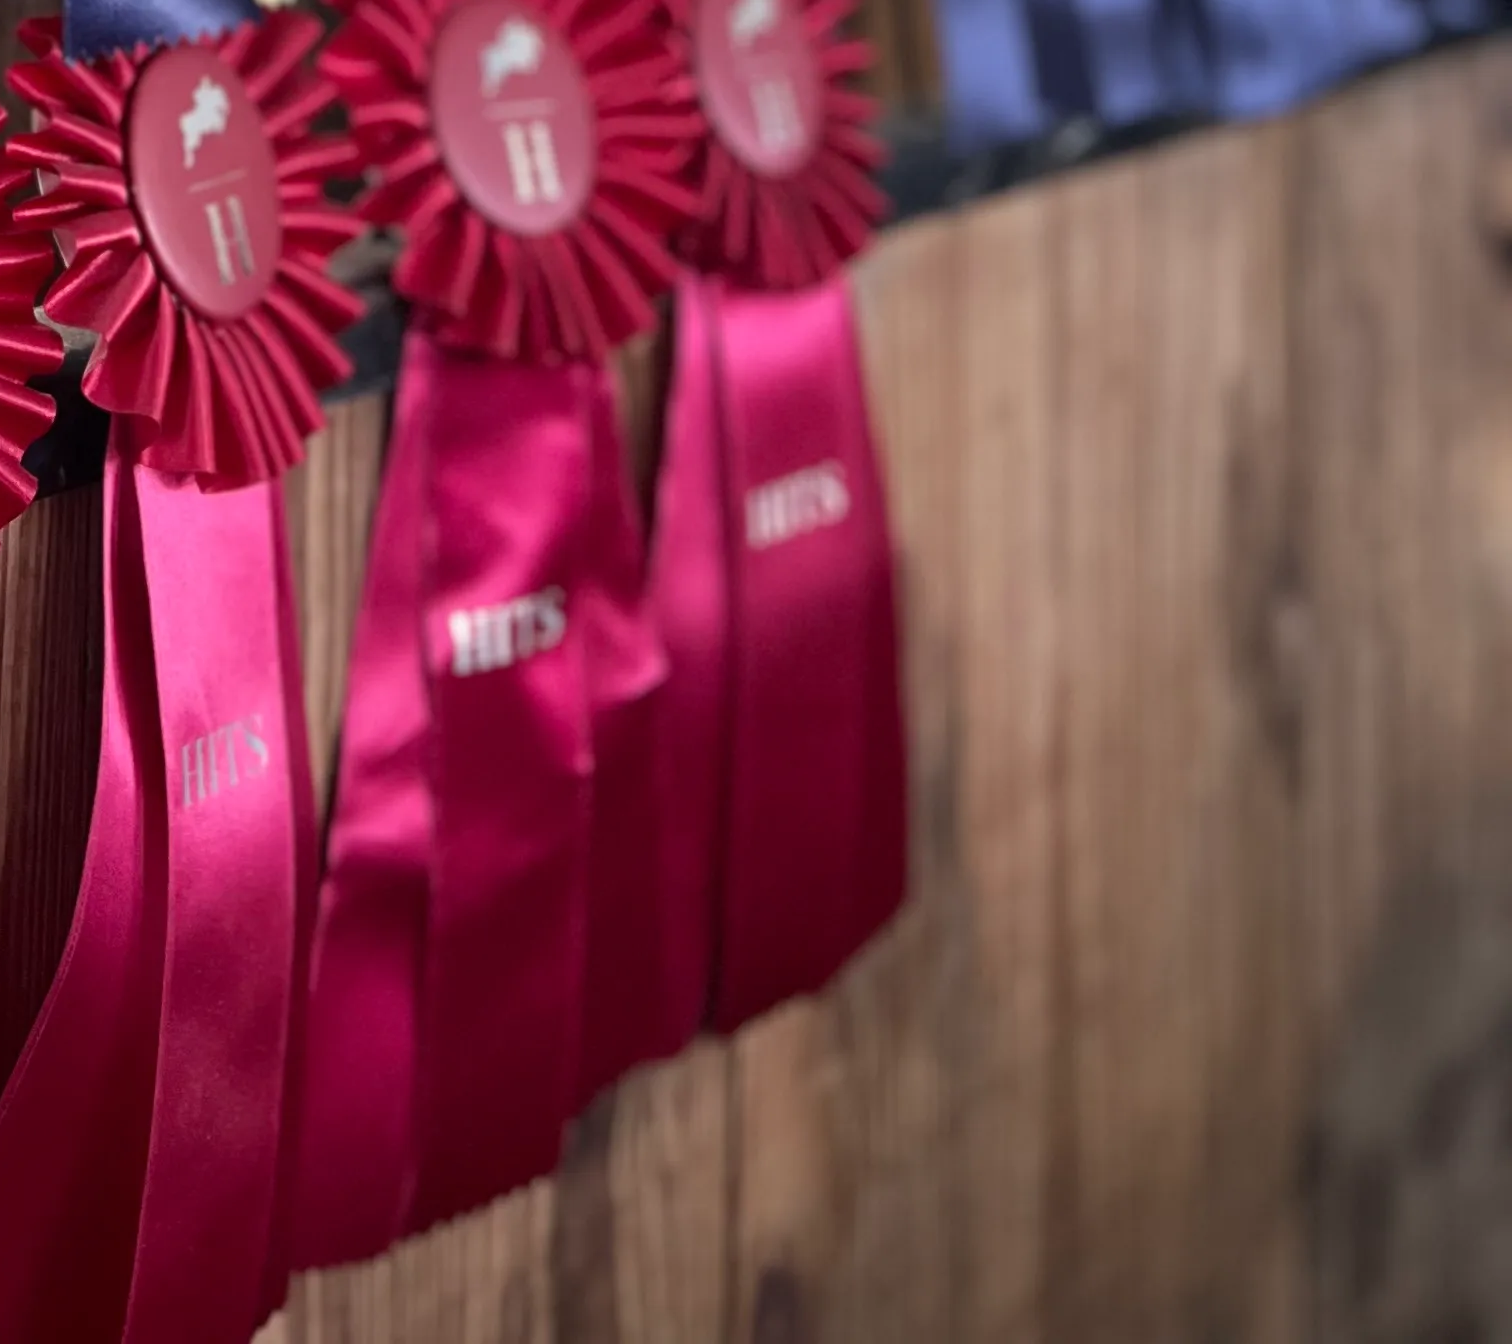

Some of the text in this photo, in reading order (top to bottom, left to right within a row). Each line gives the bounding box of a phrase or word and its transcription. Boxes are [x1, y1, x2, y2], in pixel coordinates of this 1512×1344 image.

[502, 121, 563, 205] H
[205, 197, 253, 286] H
[744, 459, 850, 551] HITS
[449, 585, 566, 678] HITS
[180, 713, 269, 808] HITS
